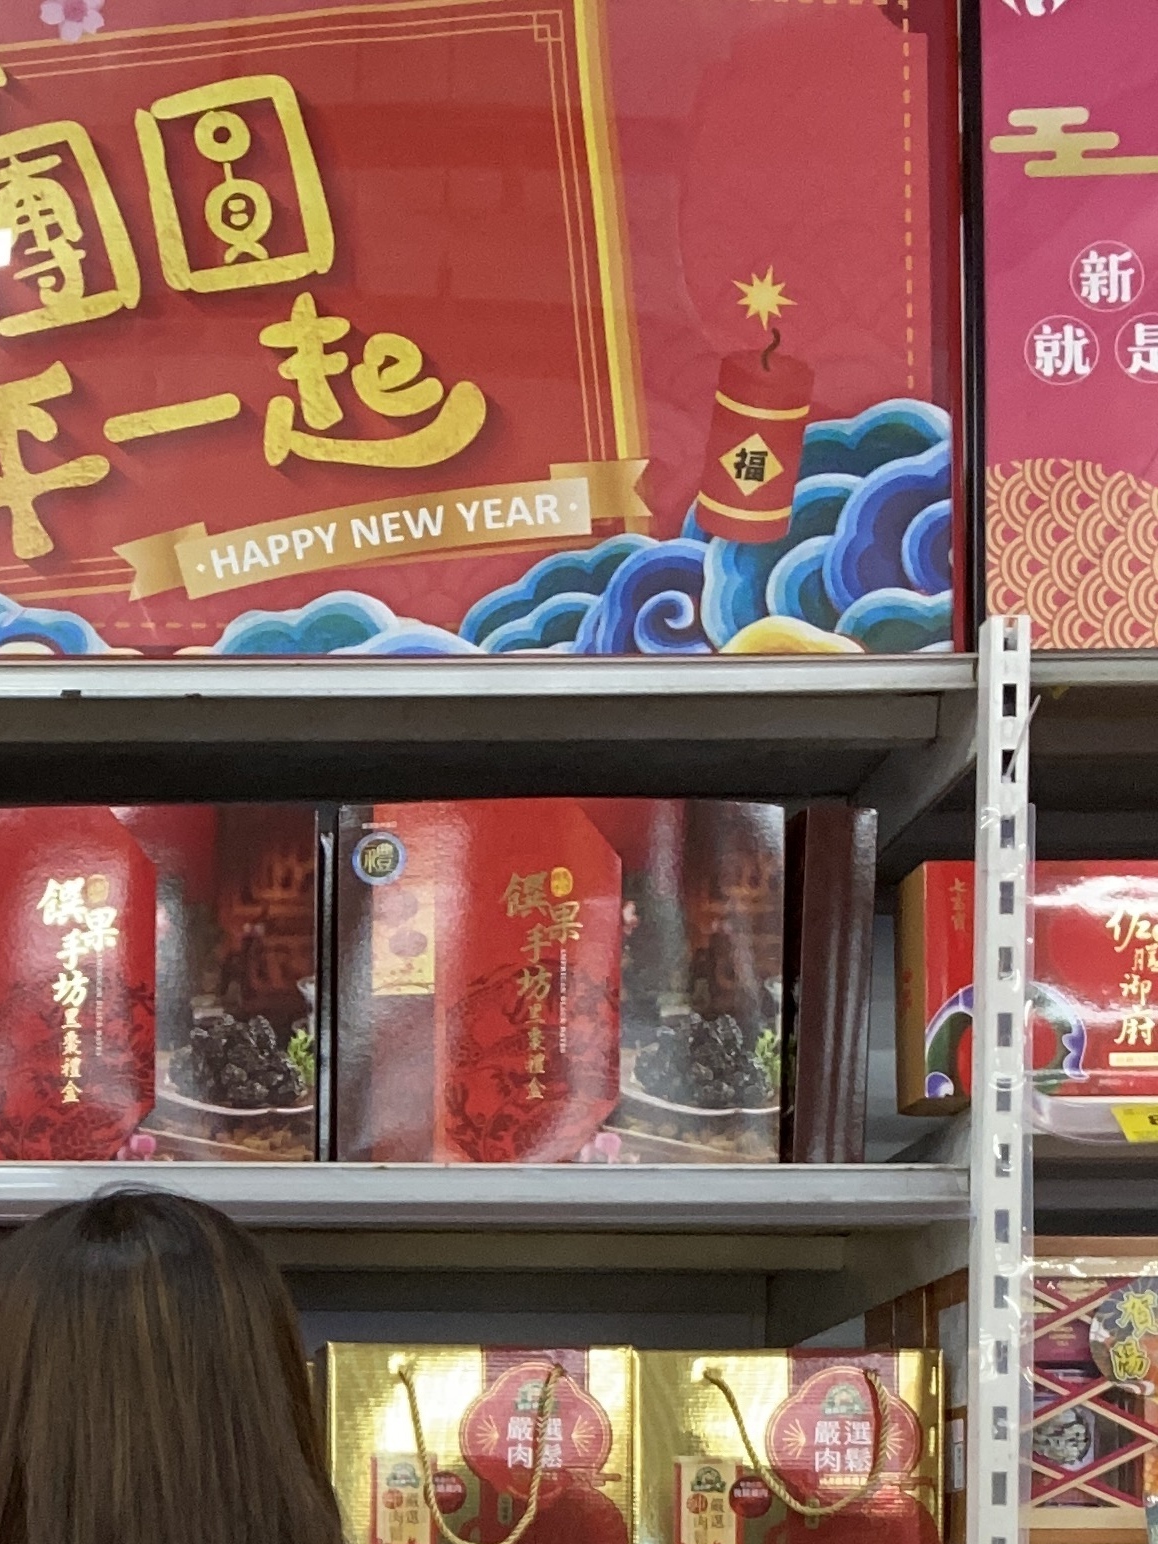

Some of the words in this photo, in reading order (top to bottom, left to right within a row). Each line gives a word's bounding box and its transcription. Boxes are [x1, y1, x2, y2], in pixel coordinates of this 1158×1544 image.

[1079, 249, 1135, 305] 新
[1033, 323, 1158, 377] 就是
[732, 447, 768, 483] 福
[210, 522, 338, 579] HAPPY
[350, 505, 445, 548] NEW
[456, 493, 562, 533] YEAR
[814, 1420, 872, 1446] 嚴選
[814, 1450, 872, 1473] 肉鬆
